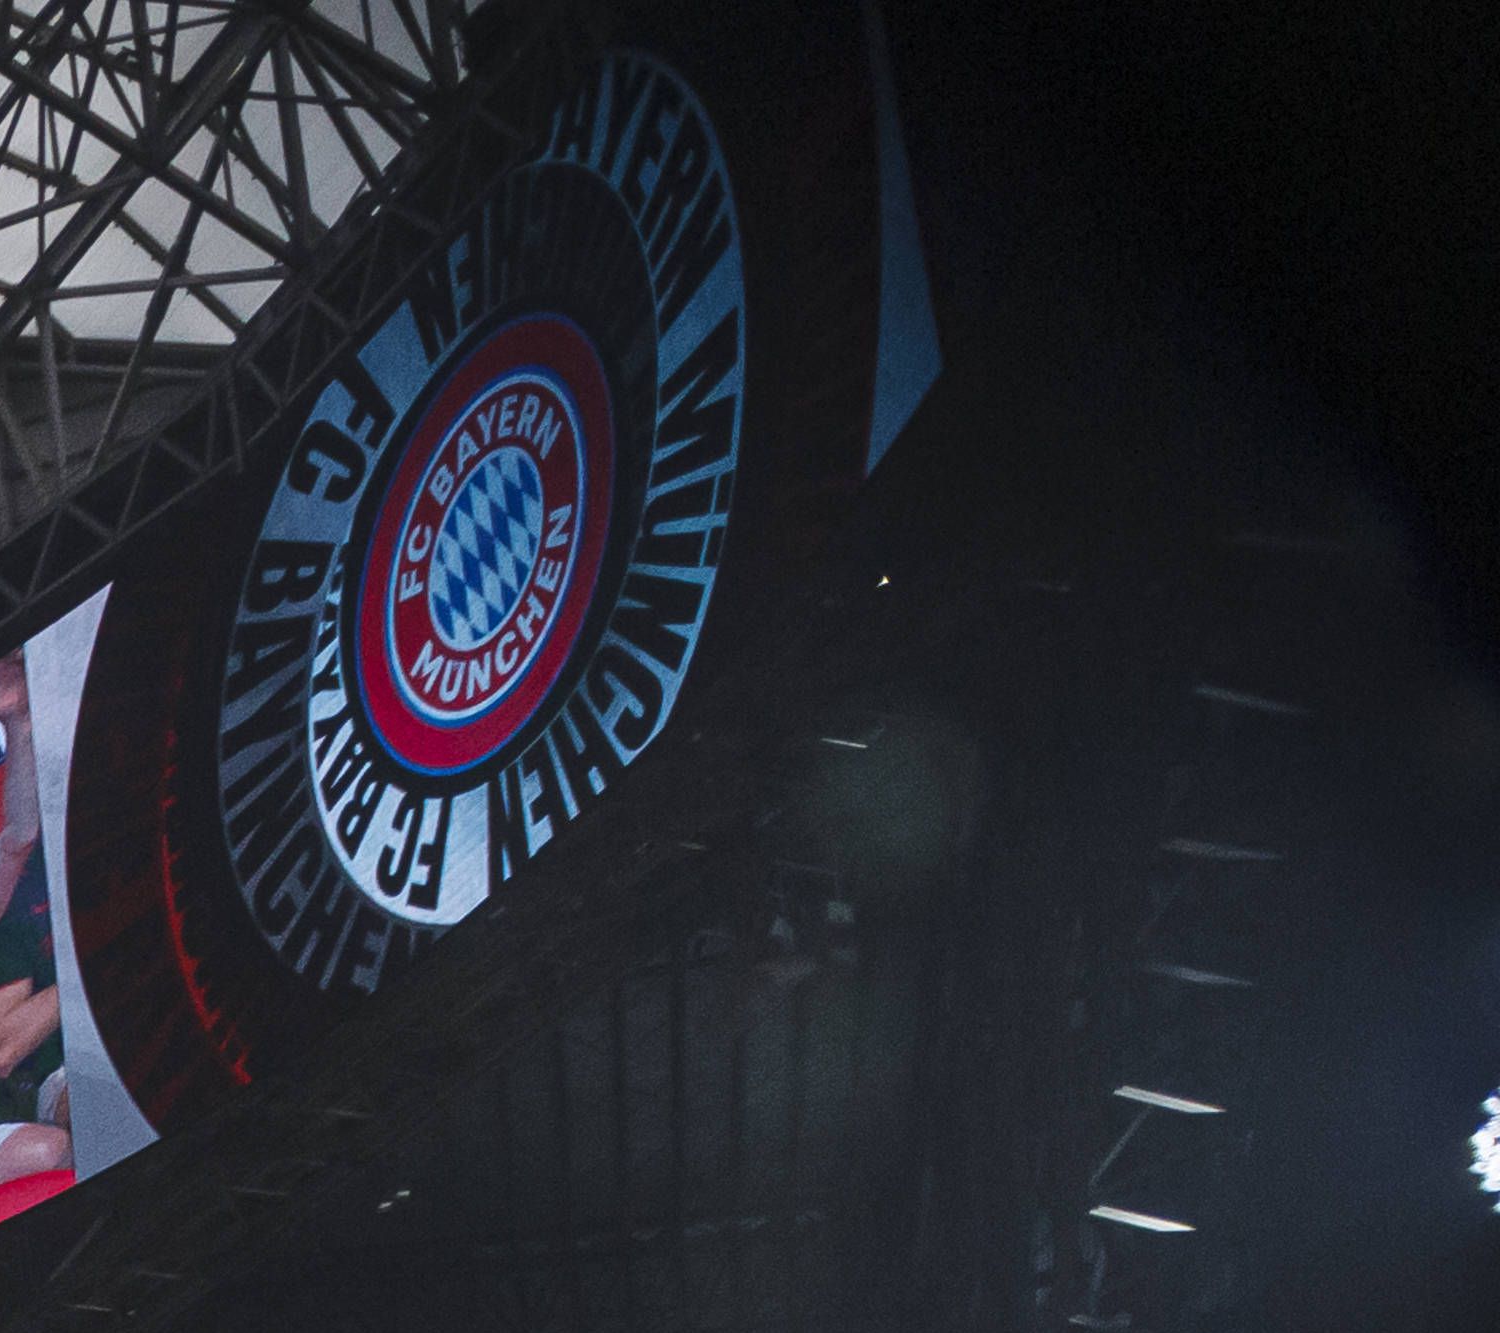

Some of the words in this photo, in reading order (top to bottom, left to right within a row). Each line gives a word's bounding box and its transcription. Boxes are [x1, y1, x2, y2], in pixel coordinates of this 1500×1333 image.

[398, 522, 433, 603] FC
[427, 393, 563, 507] BAYERN
[409, 503, 574, 705] MÜNCHEN
